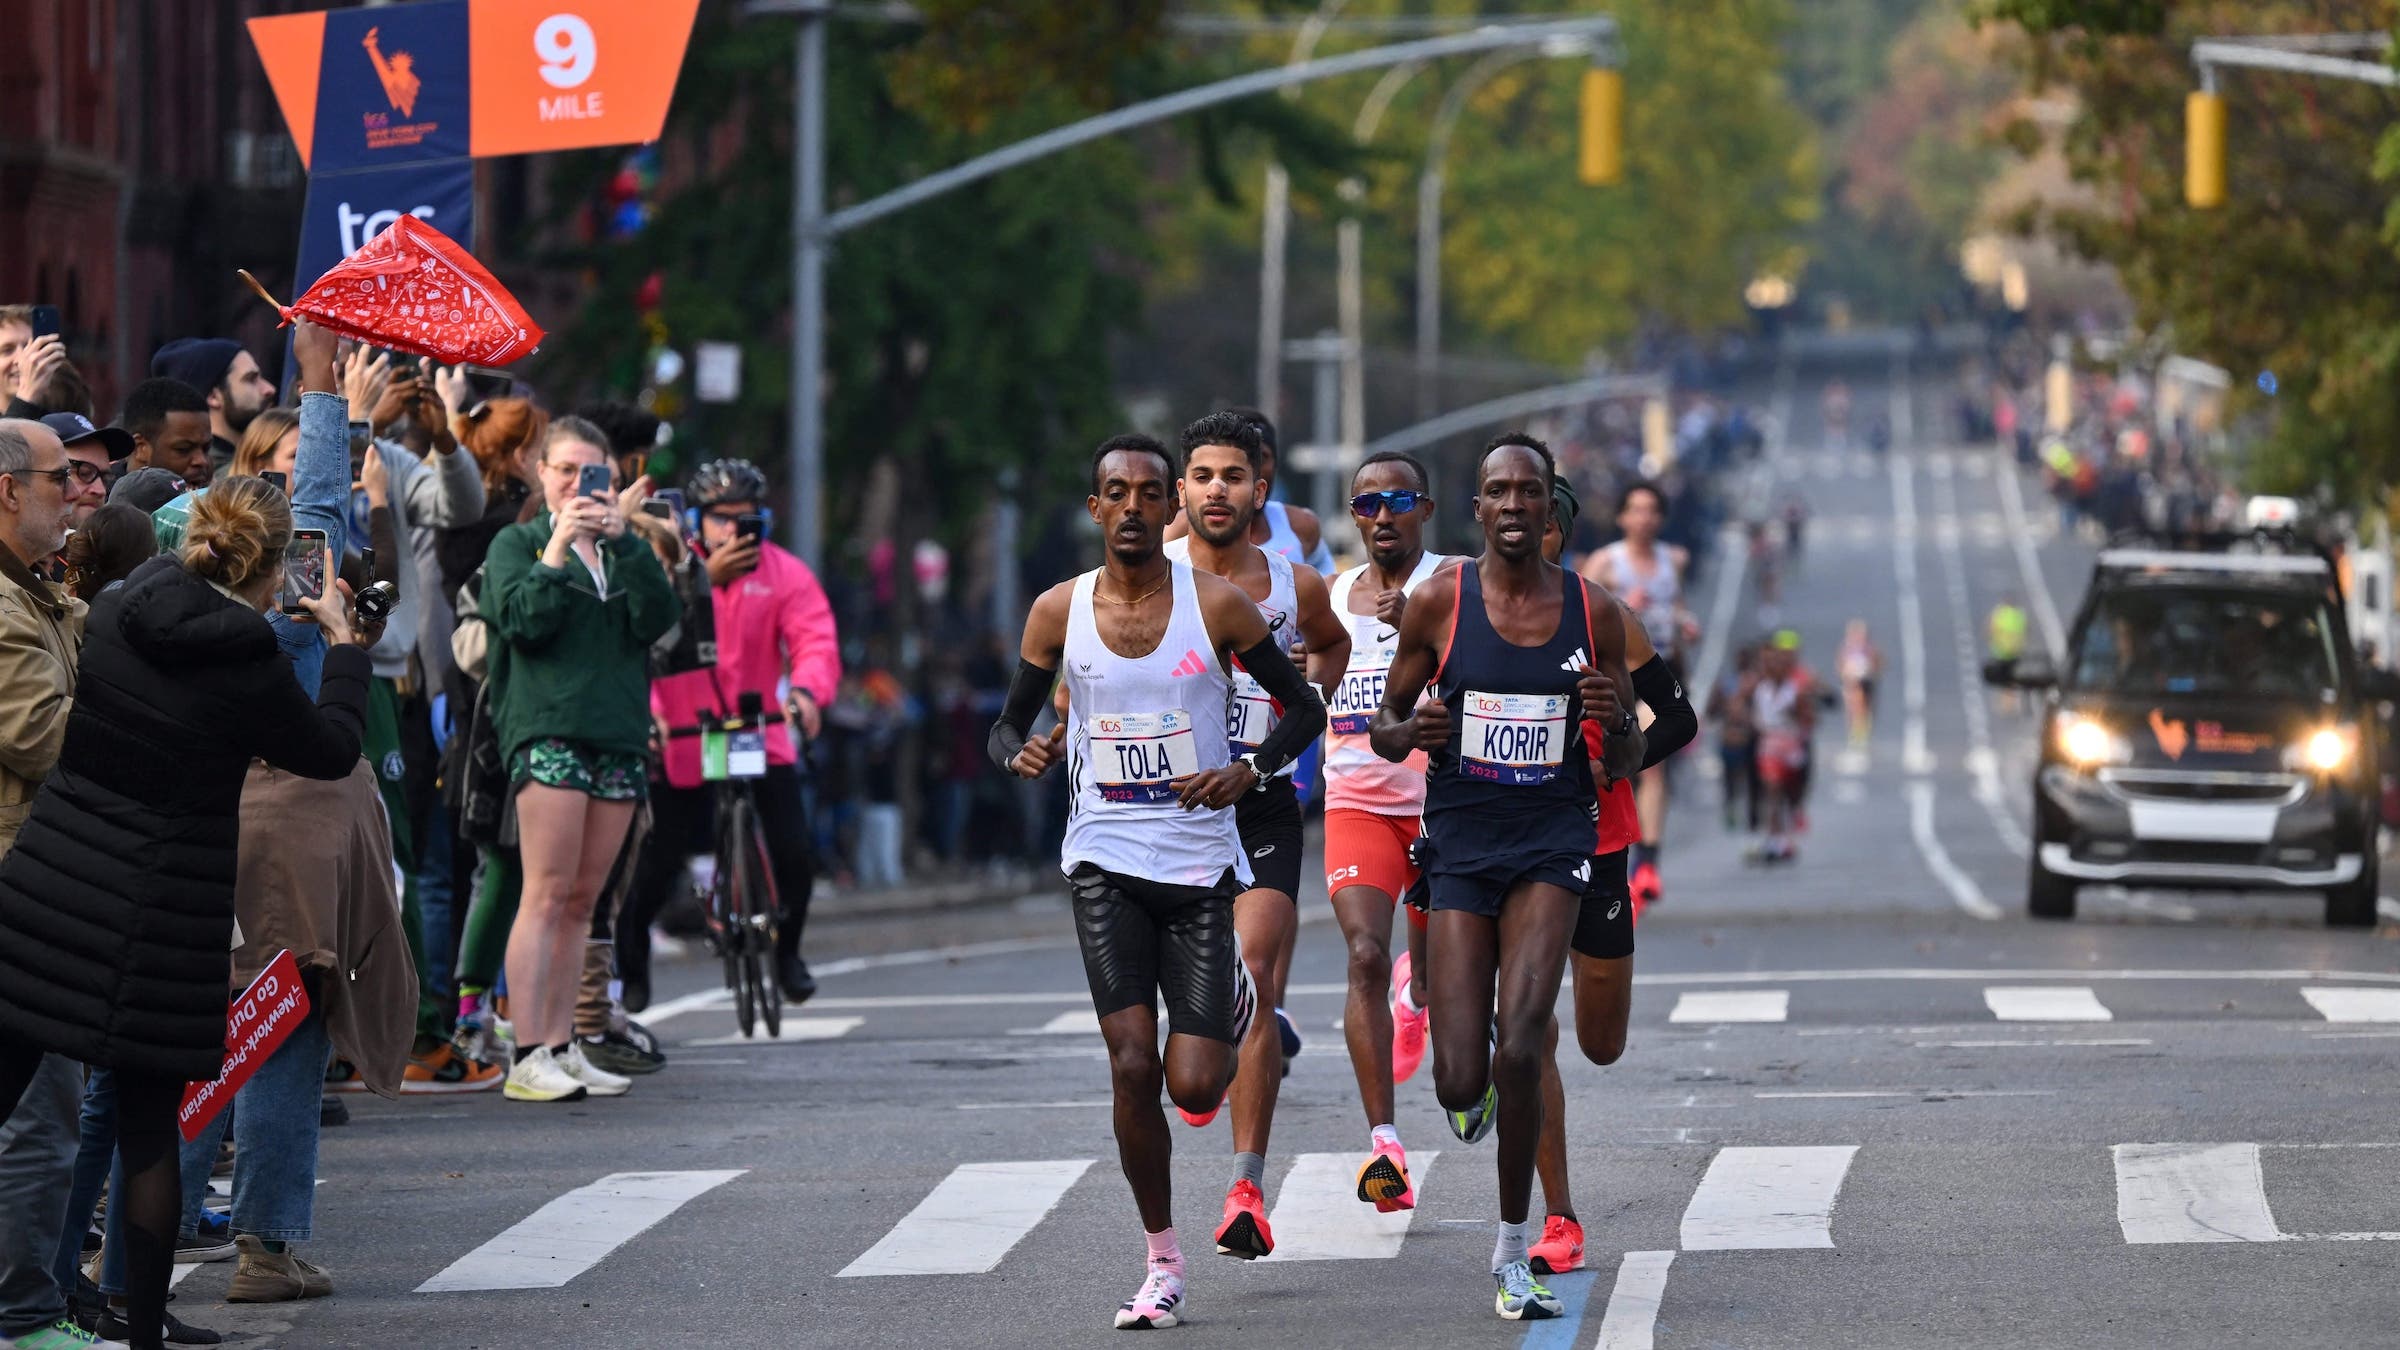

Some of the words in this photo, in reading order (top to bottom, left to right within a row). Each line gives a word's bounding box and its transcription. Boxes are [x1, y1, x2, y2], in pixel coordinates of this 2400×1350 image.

[533, 13, 597, 89] 9
[538, 91, 605, 122] MILE
[337, 201, 436, 259] tc
[1331, 674, 1388, 713] NAGEE
[1479, 697, 1502, 713] tcs
[1162, 722, 1178, 730] TATA
[1333, 720, 1356, 732] 2023
[1483, 724, 1549, 761] KORIR
[1115, 742, 1173, 780] TOLA
[1469, 765, 1499, 780] 2023
[1103, 790, 1134, 801] 2023
[256, 975, 279, 1002] Go
[228, 998, 258, 1040] Duf
